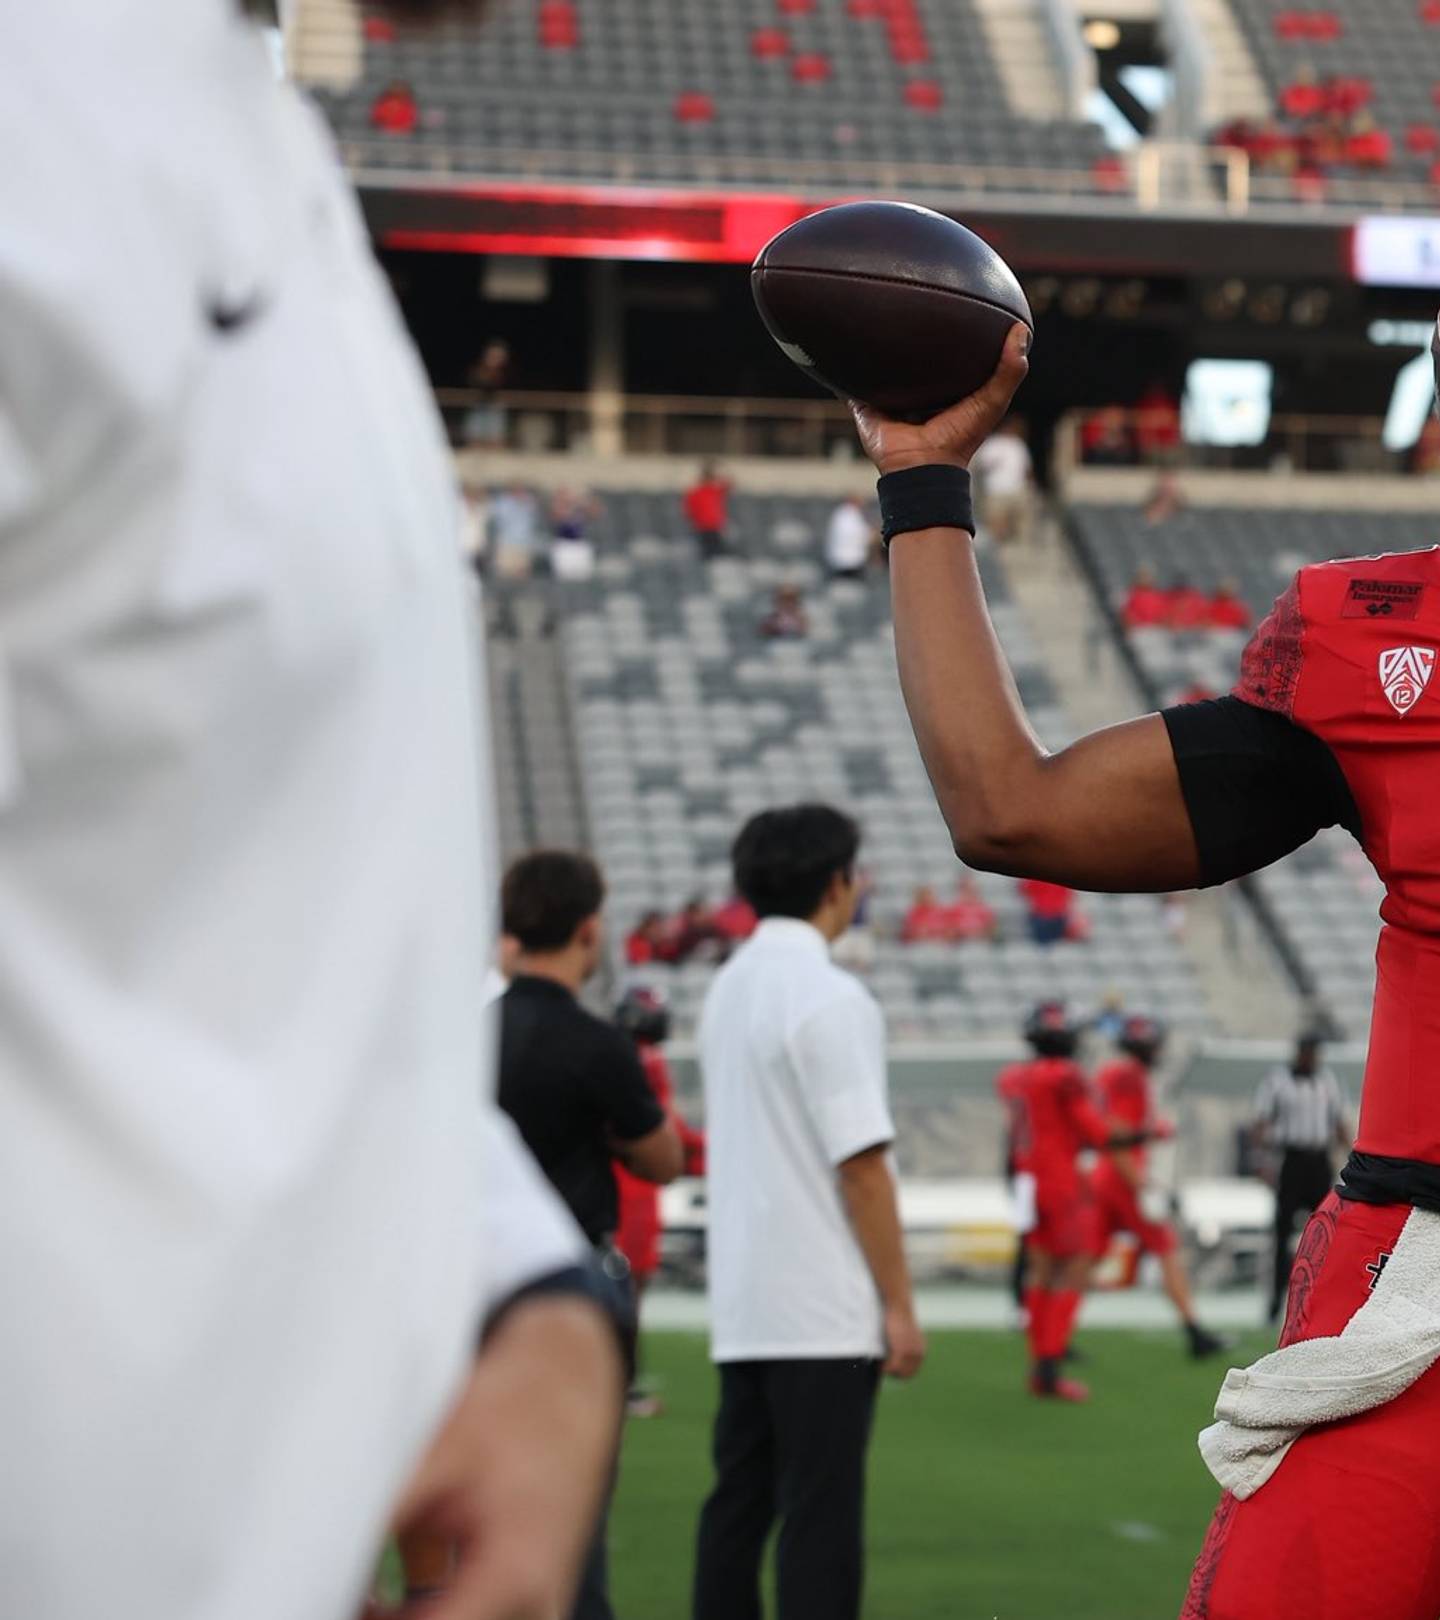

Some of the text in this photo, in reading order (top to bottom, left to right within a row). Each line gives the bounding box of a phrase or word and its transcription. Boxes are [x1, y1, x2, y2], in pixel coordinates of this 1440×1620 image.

[1350, 579, 1424, 595] Palomar
[1379, 647, 1435, 688] PAC
[1395, 690, 1411, 704] 12
